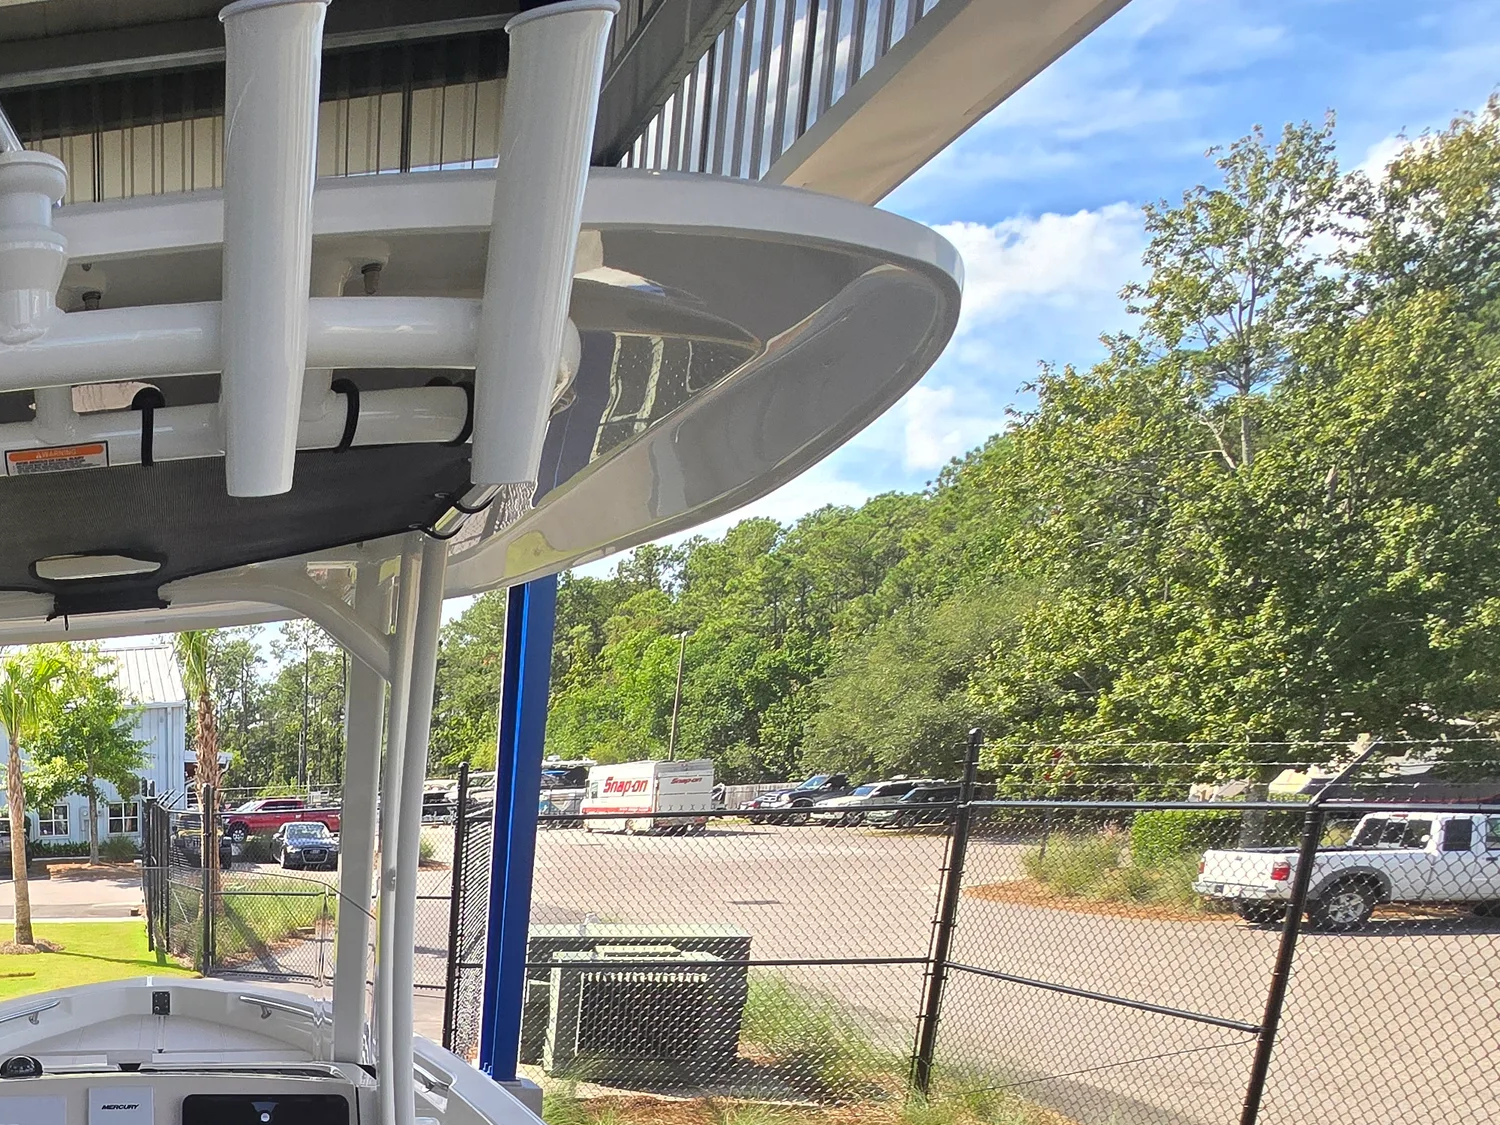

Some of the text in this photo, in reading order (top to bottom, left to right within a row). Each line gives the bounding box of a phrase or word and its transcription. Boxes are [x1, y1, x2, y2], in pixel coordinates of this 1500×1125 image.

[41, 448, 77, 458] WARNING
[670, 777, 703, 785] Snap-on
[603, 776, 649, 797] Snap-on
